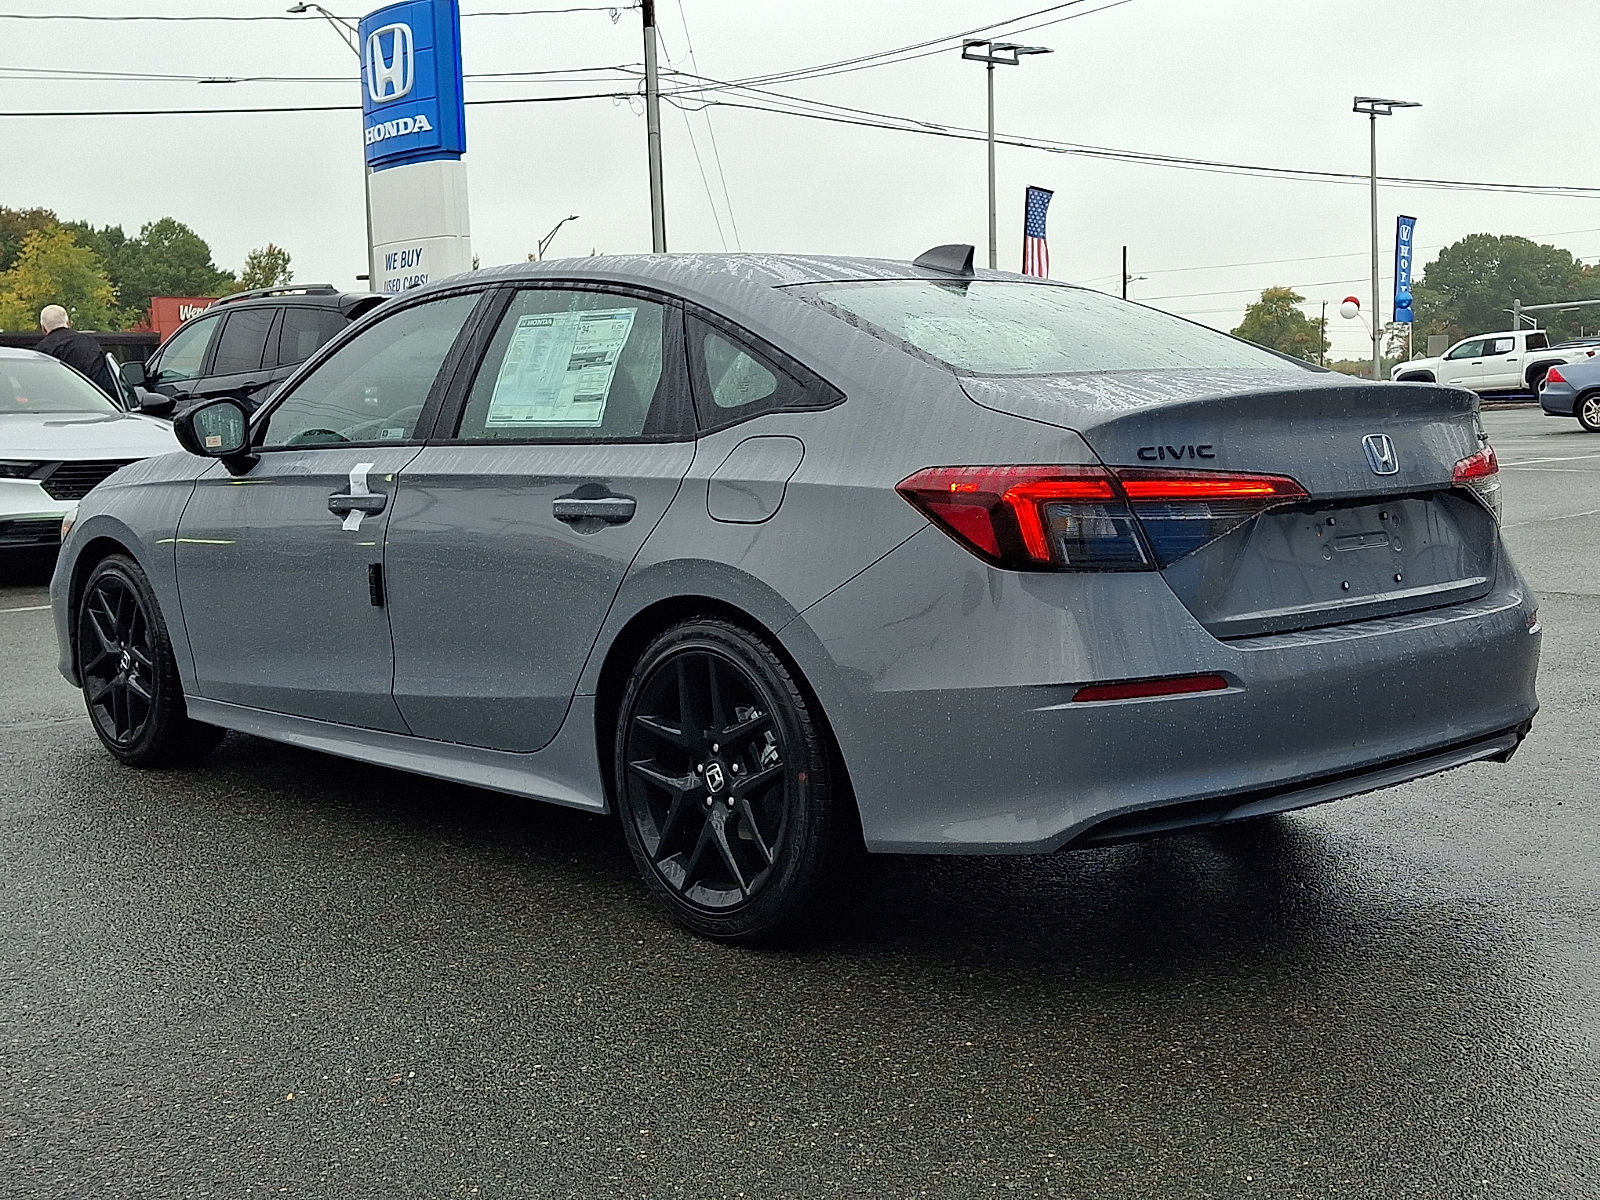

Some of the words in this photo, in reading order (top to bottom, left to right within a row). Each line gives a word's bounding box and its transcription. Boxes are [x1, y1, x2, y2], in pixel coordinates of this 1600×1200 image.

[365, 115, 432, 145] HONDA
[385, 252, 398, 271] WE
[400, 248, 422, 269] BUY
[526, 319, 553, 327] HONDA
[1137, 445, 1215, 460] CIVIC
